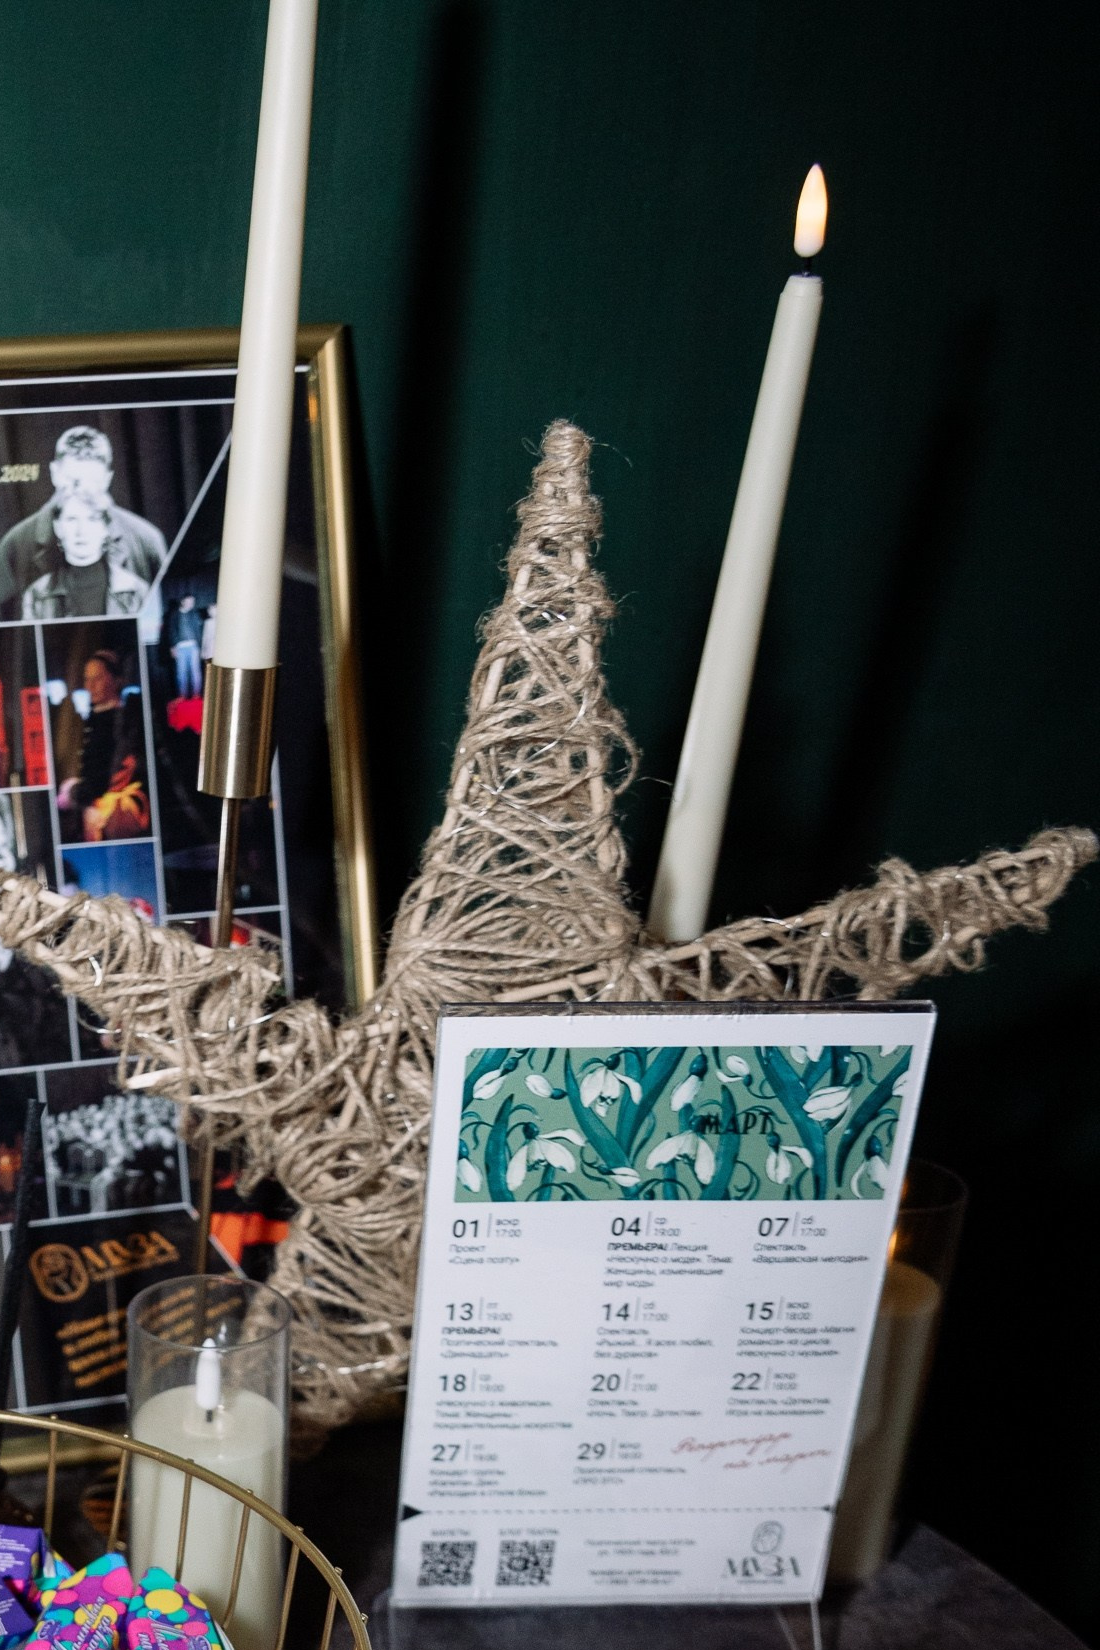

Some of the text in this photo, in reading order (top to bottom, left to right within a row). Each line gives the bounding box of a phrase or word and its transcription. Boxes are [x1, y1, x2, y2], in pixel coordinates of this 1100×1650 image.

[701, 1111, 772, 1135] МАРТ
[451, 1218, 481, 1238] 01
[609, 1217, 642, 1236] 04
[757, 1217, 790, 1237] 07
[444, 1302, 474, 1321] 13
[601, 1301, 630, 1321] 14
[744, 1301, 774, 1321] 15
[438, 1373, 467, 1392] 18
[591, 1373, 621, 1392] 20
[730, 1372, 761, 1391] 22
[431, 1443, 461, 1462] 27
[576, 1442, 606, 1460] 29
